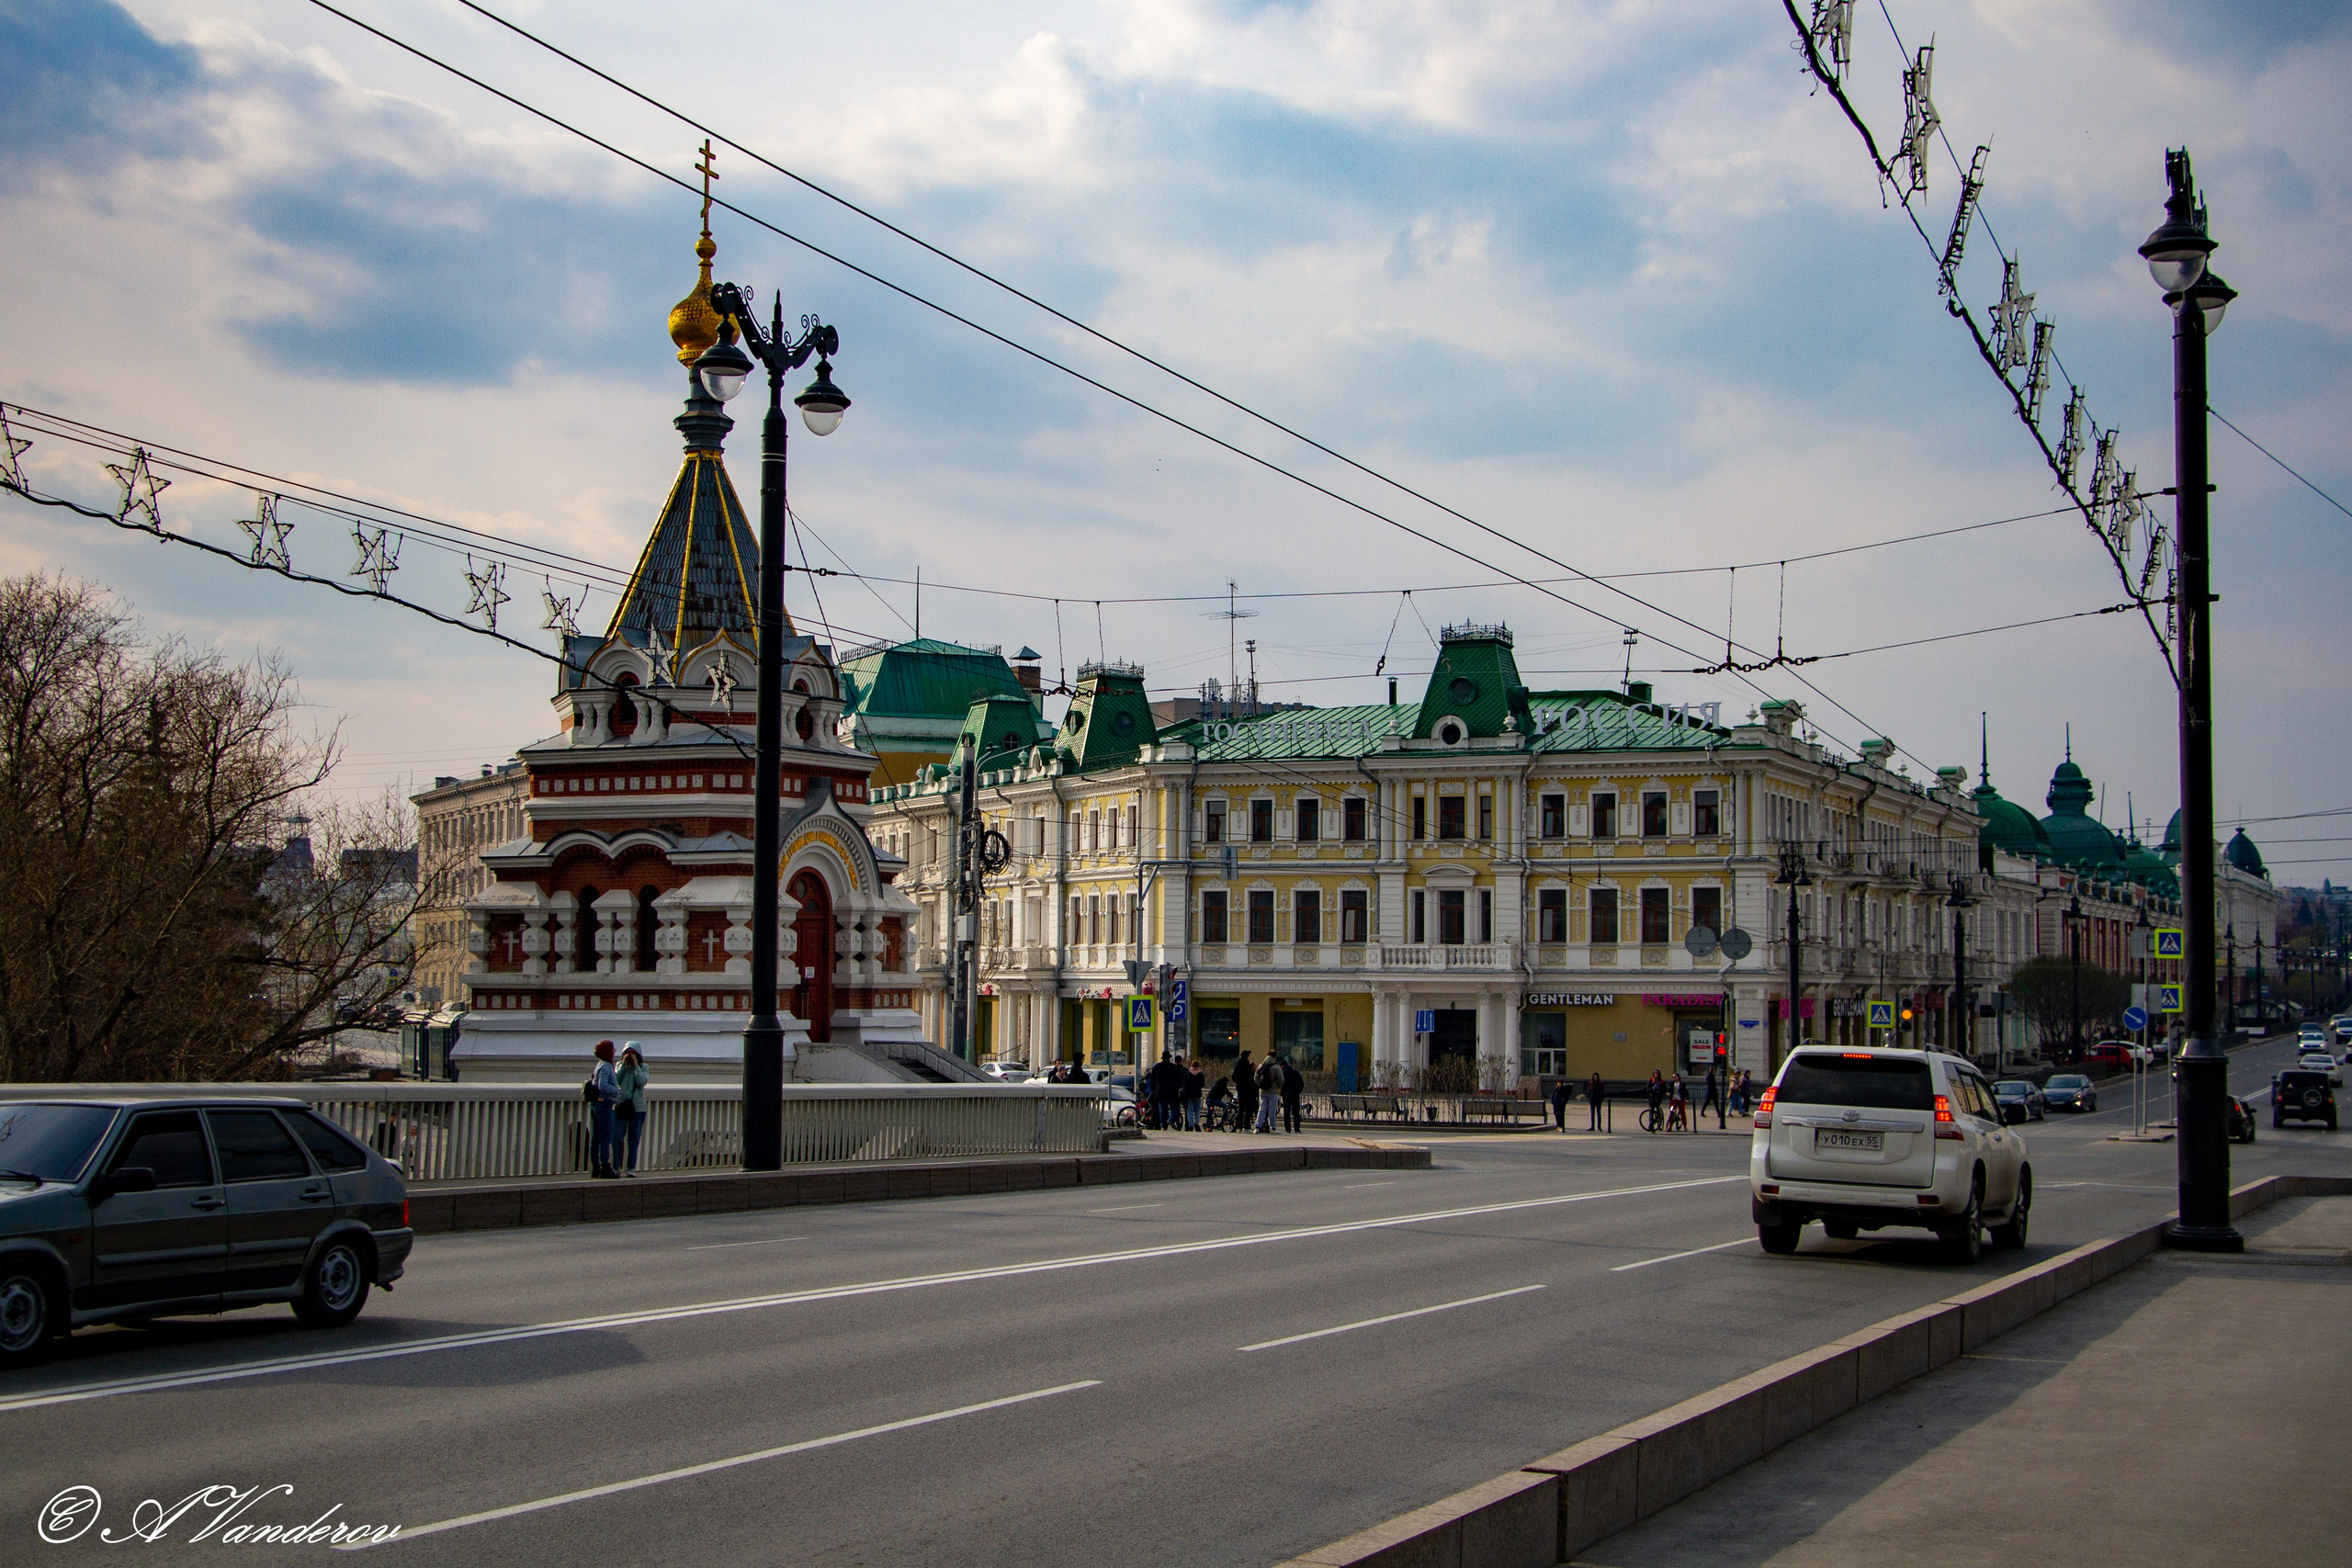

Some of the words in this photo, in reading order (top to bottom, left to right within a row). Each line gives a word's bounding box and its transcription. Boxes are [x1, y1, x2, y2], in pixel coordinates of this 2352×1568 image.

[1203, 720, 1373, 743] ГОСТИНИЦА
[1535, 702, 1723, 736] РОССИЯ
[1529, 994, 1614, 1006] GENTLEMAN
[1832, 998, 1866, 1018] GENTLEMAN
[1172, 1004, 1183, 1021] P
